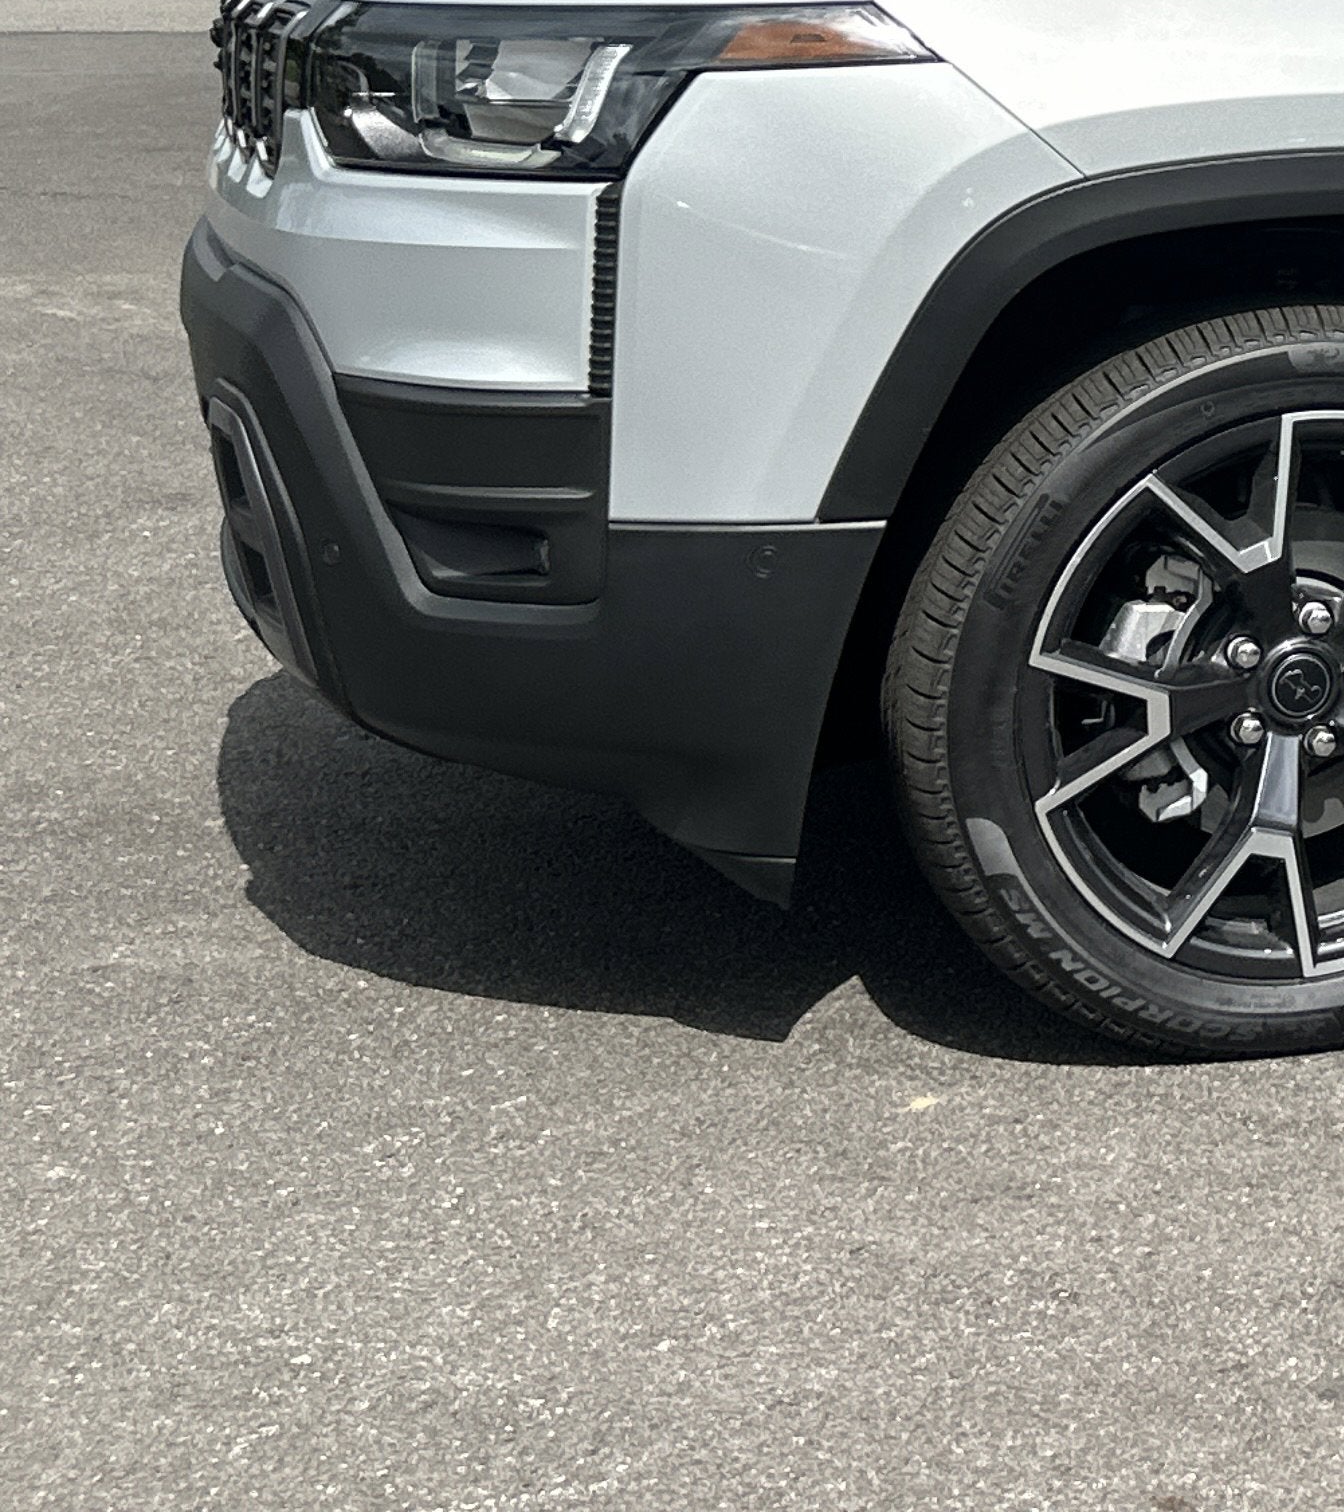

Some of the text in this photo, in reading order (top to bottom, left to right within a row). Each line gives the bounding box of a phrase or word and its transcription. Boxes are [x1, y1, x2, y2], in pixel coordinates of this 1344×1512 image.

[984, 493, 1065, 610] PIRELLI
[999, 887, 1264, 1041] SCORPION MS
